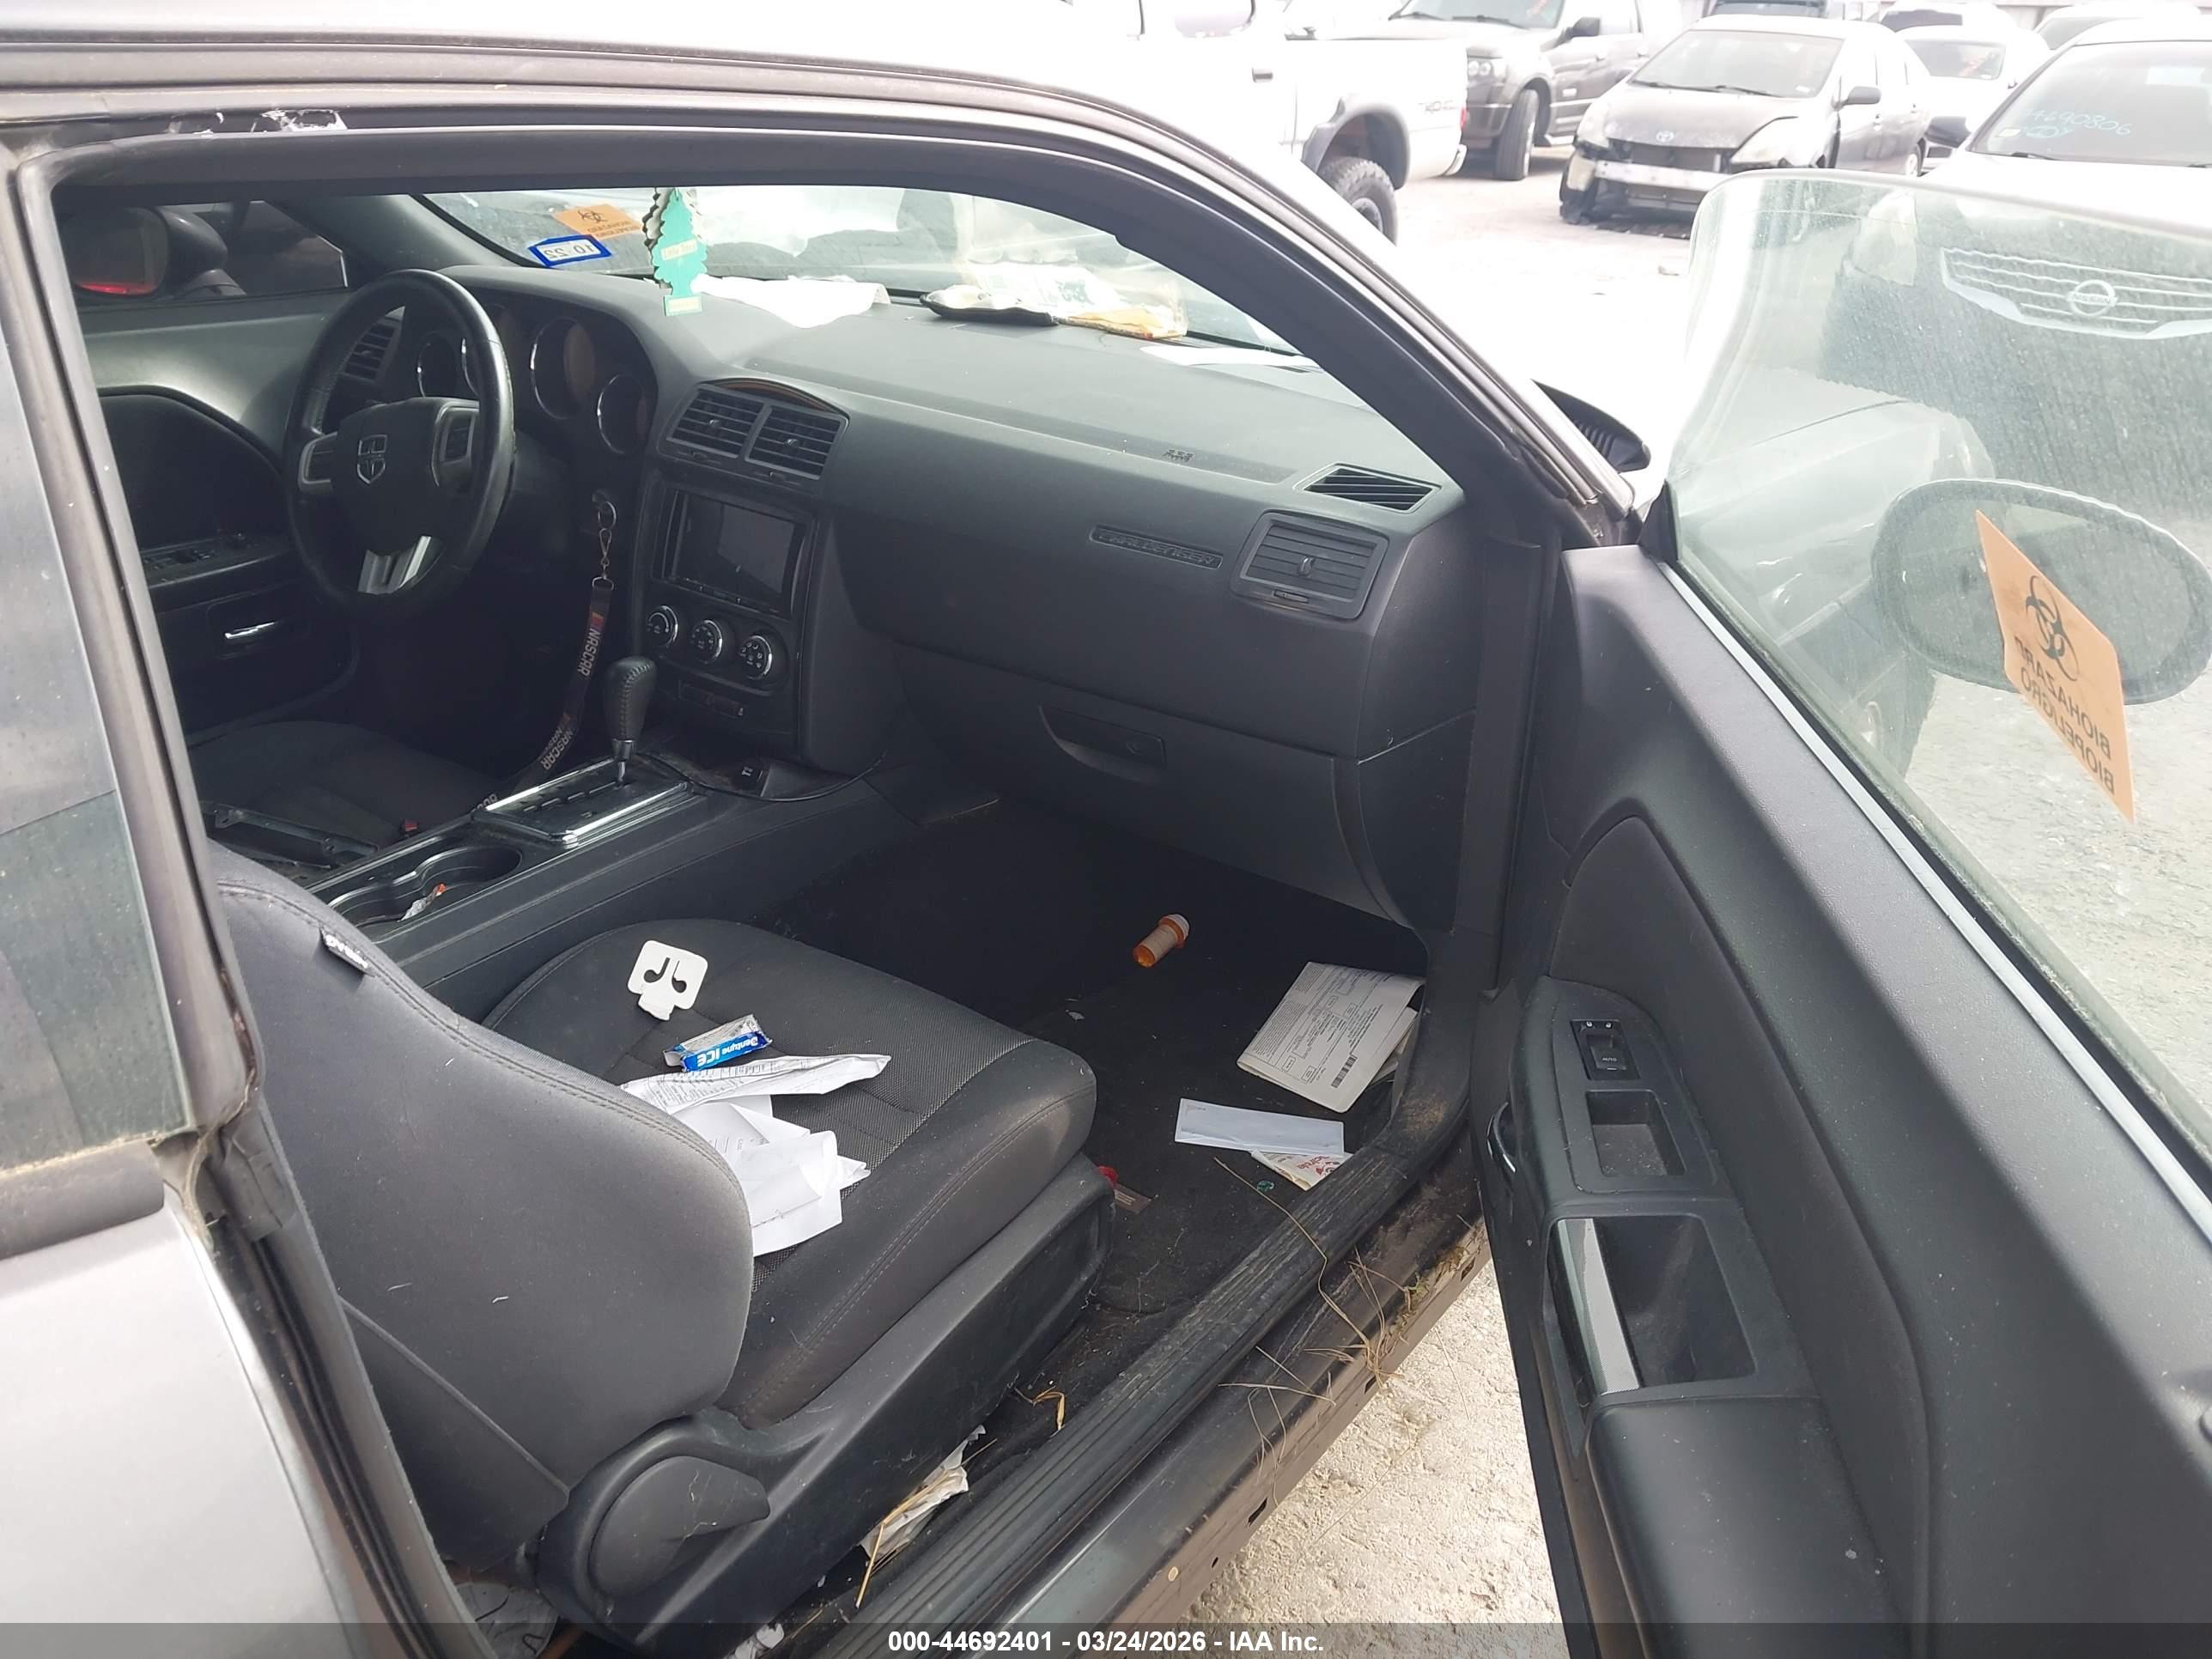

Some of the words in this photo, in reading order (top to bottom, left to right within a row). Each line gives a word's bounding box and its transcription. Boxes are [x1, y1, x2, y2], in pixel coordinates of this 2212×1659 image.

[577, 627, 602, 678] NASCAR
[540, 728, 574, 771] NASCAR
[696, 1048, 720, 1067] ICE
[722, 1036, 759, 1055] Dentyne
